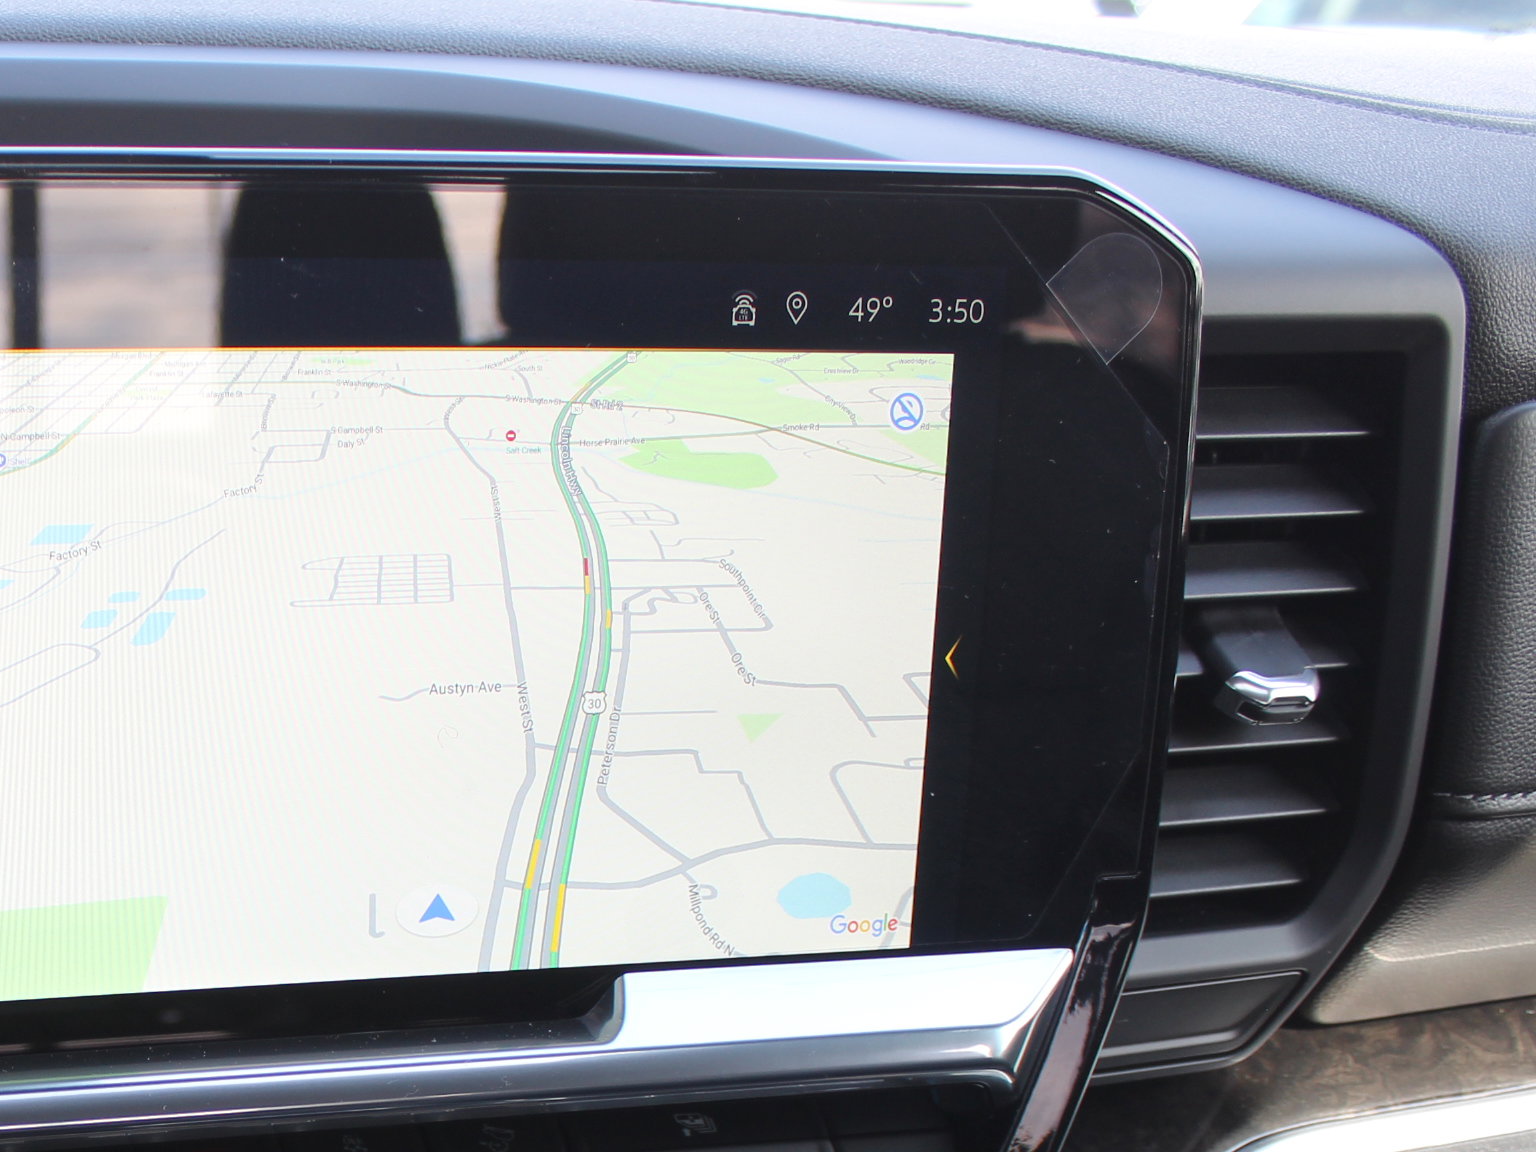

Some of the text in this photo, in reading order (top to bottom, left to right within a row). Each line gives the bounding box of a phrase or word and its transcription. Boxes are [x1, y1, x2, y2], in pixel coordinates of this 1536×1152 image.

[929, 299, 985, 324] 3:50
[10, 433, 51, 442] Campbell
[782, 423, 820, 431] Smoke Rd
[337, 440, 355, 449] Daly
[522, 446, 542, 454] Creek
[561, 425, 573, 470] Lincoln
[579, 439, 603, 447] Horse
[604, 438, 630, 446] Prairie
[224, 473, 265, 498] Factory St
[48, 540, 103, 561] Factory St
[718, 558, 767, 619] Southpoint Cir
[699, 591, 720, 624] Ore St
[731, 652, 757, 687] Ore St
[429, 681, 502, 697] Austyn Ave
[517, 681, 534, 734] West St
[587, 698, 602, 709] 30
[597, 706, 622, 786] Peterson Dr
[688, 883, 735, 957] Millpond Rd N
[830, 913, 898, 937] Google
